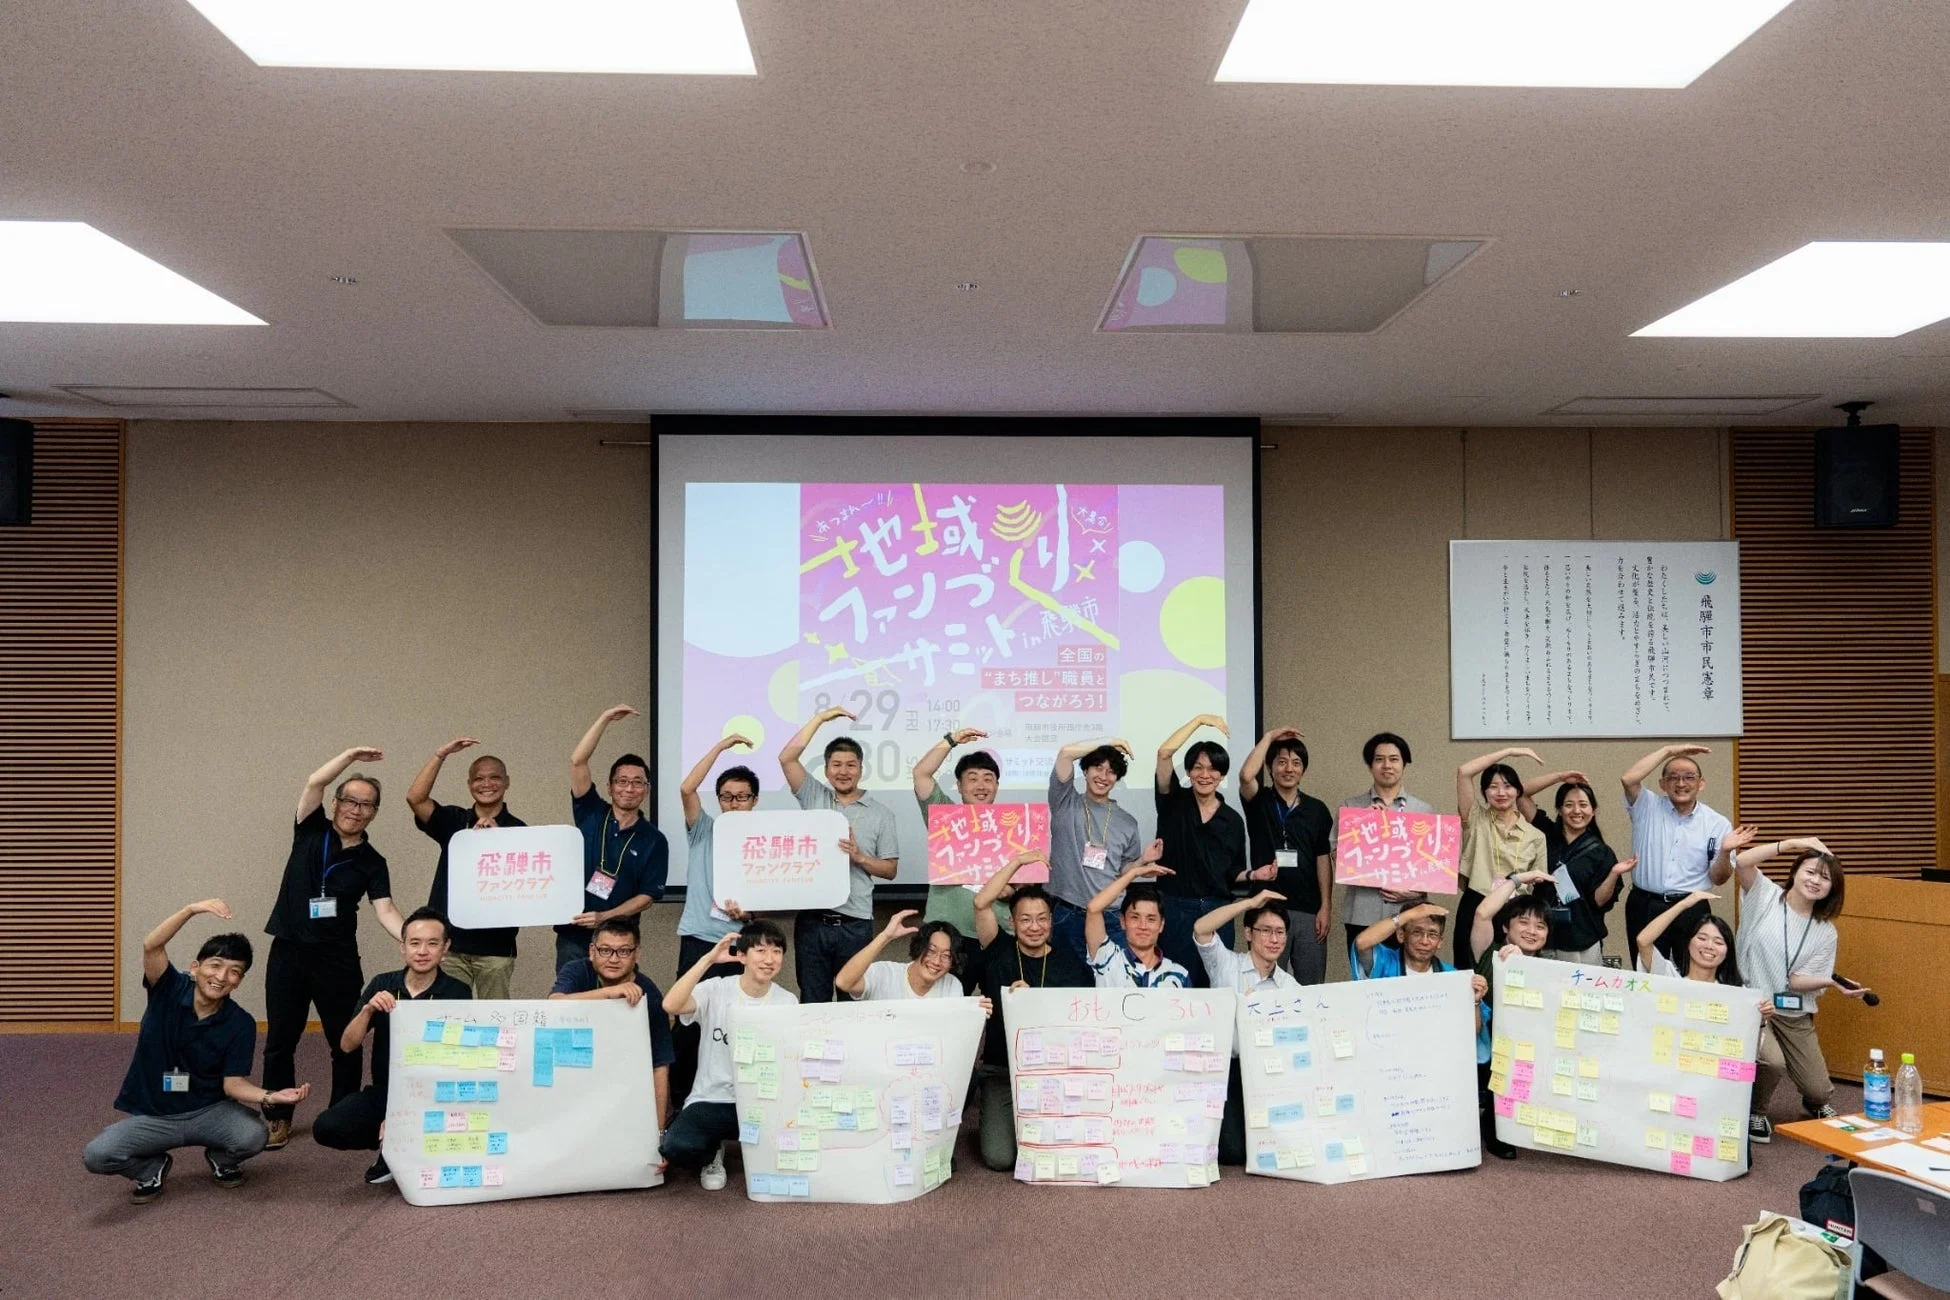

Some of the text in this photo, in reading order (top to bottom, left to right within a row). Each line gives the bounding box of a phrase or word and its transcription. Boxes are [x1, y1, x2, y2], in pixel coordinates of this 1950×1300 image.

[1060, 648, 1104, 662] 全国の
[928, 699, 960, 712] 14:00
[928, 719, 961, 732] 17:30
[743, 835, 817, 859] 飛騨市
[477, 851, 552, 876] 飛騨市
[742, 859, 820, 875] ファンクラブ
[477, 875, 554, 892] ファンクラブ
[1571, 969, 1651, 992] チームカオス
